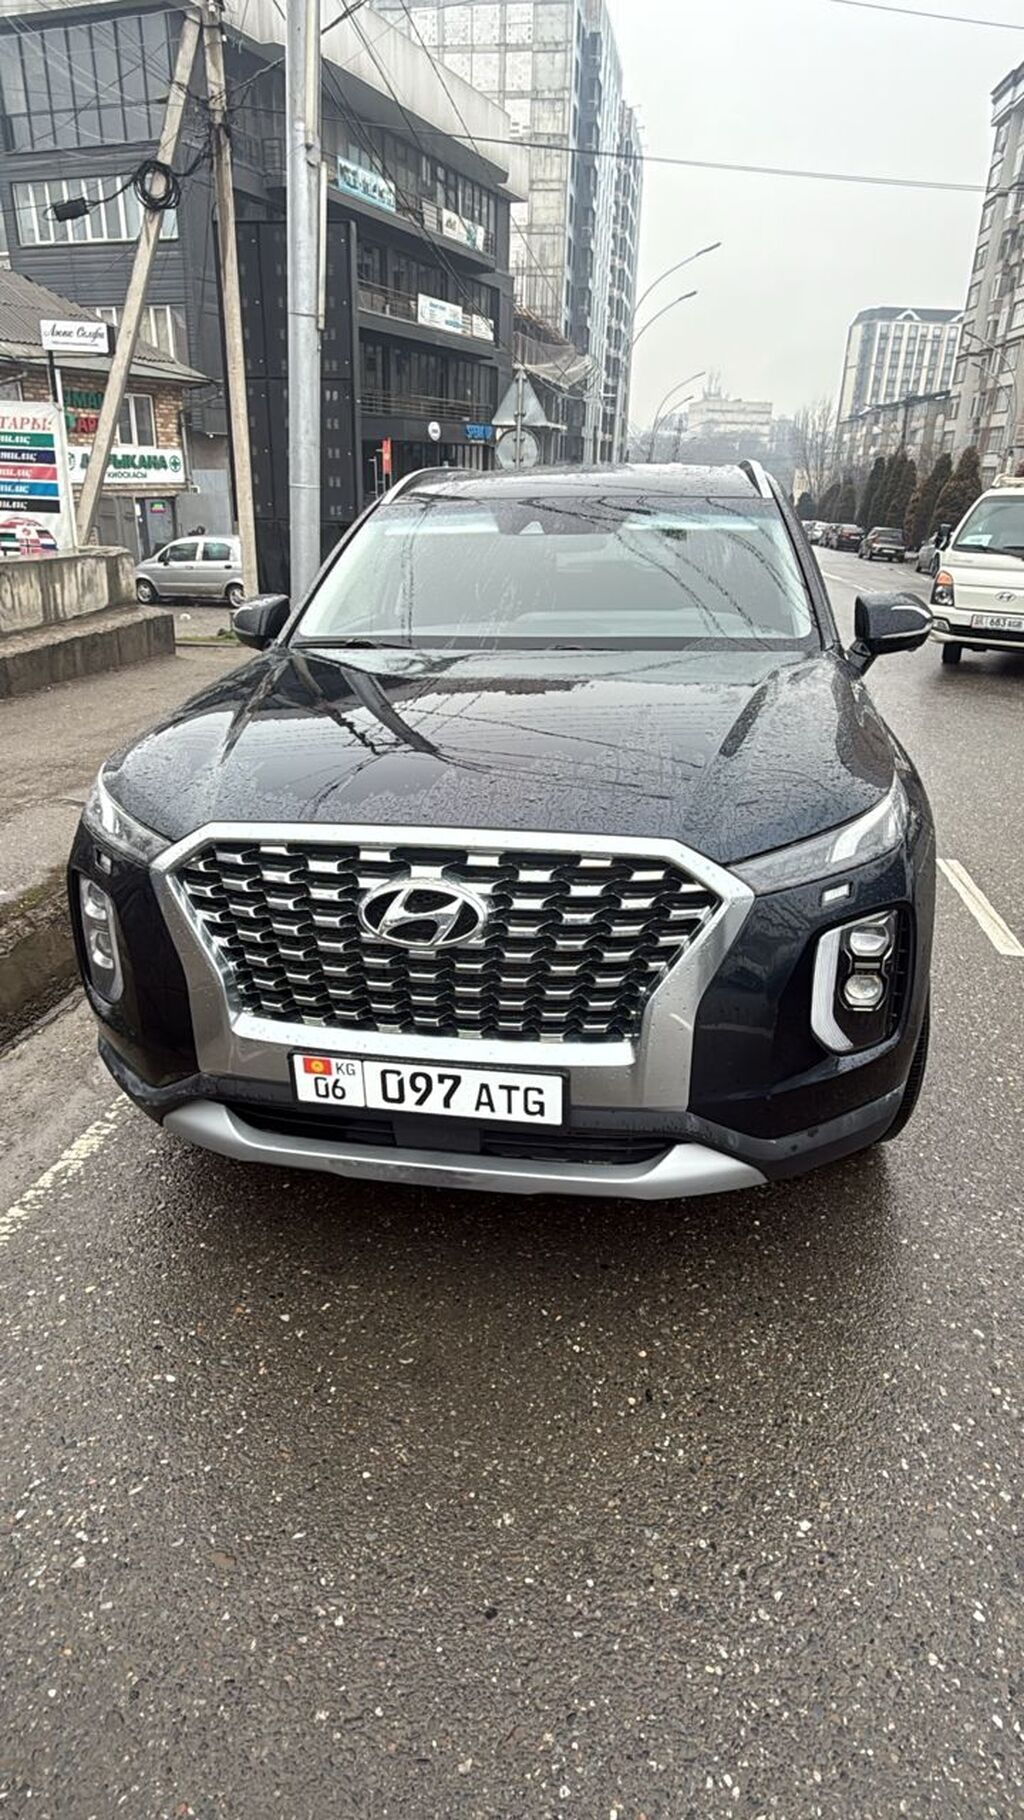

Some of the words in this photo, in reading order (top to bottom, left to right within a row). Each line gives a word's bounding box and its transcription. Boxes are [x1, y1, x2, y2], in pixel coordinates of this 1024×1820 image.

[80, 453, 168, 470] ДРЫКАНА
[335, 1062, 356, 1076] KG
[314, 1076, 346, 1100] 06
[380, 1068, 462, 1109] 097
[474, 1082, 546, 1118] ATG
